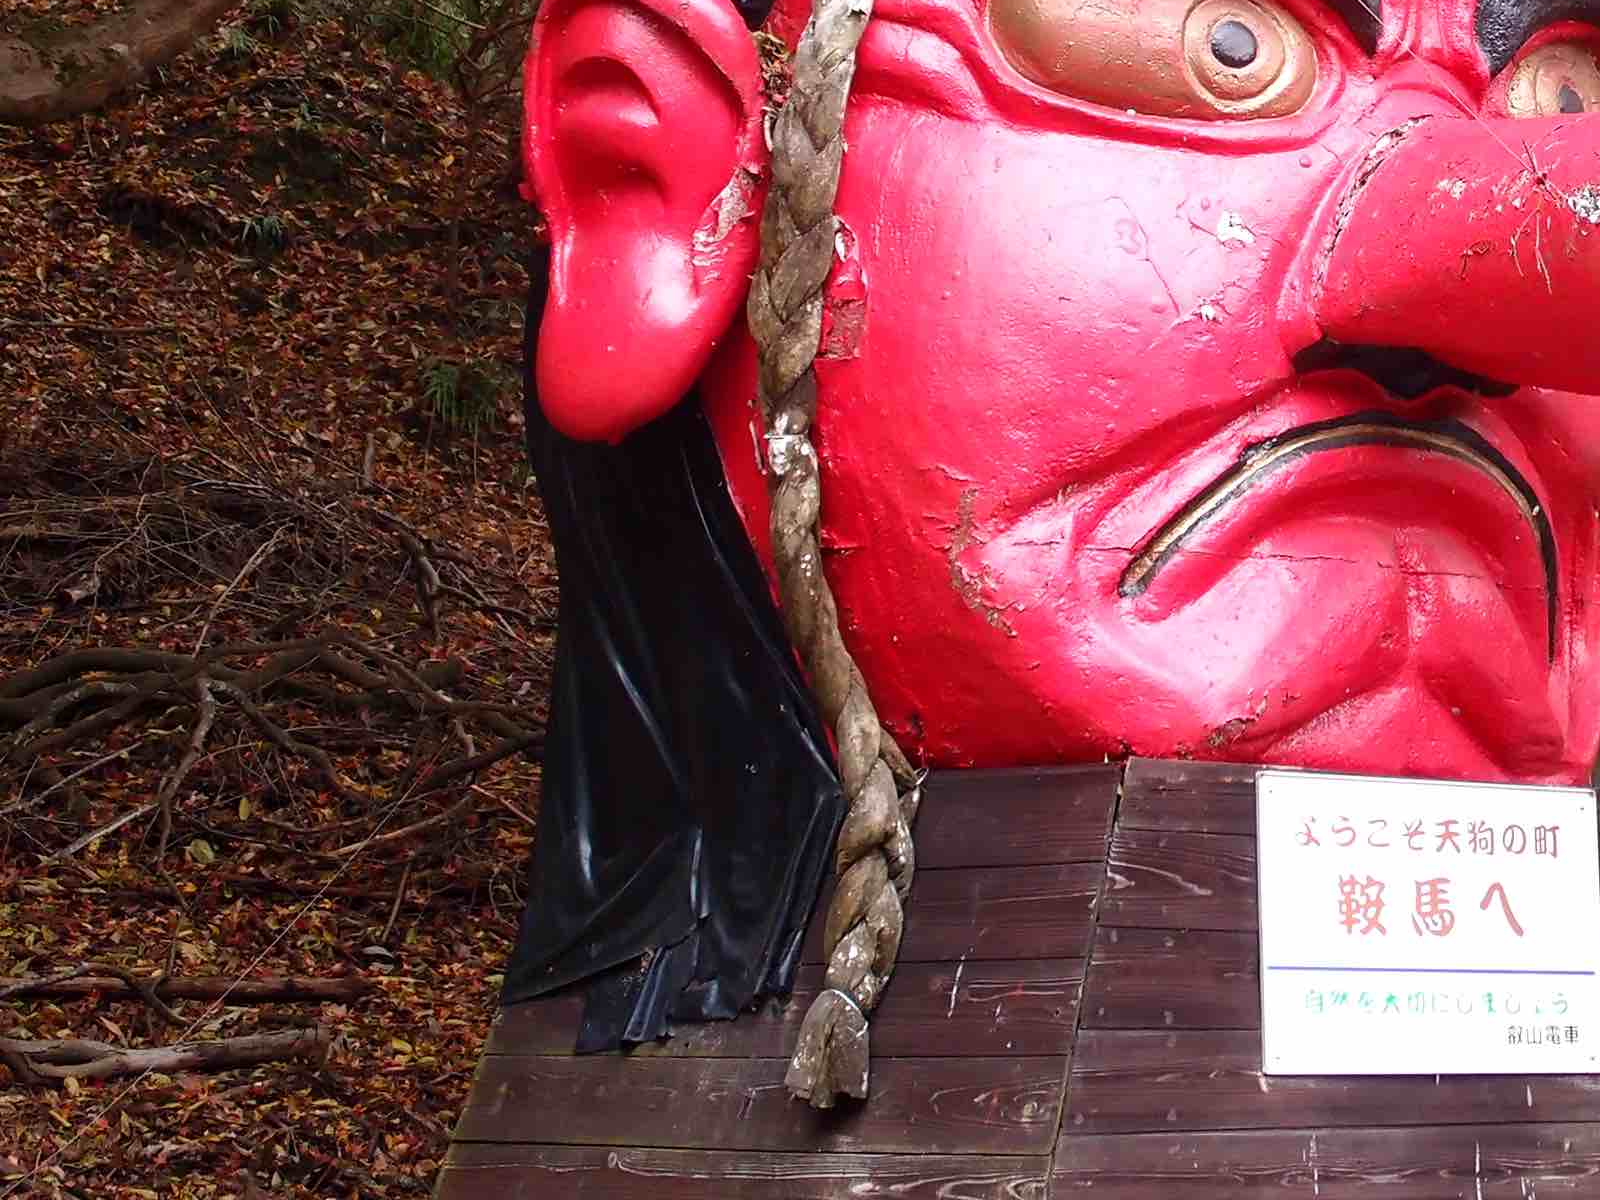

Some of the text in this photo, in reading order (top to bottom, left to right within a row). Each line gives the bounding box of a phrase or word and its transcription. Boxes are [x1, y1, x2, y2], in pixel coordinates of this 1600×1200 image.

[1296, 815, 1560, 859] ようこそ天狗の町
[1338, 874, 1524, 937] 鞍馬へ
